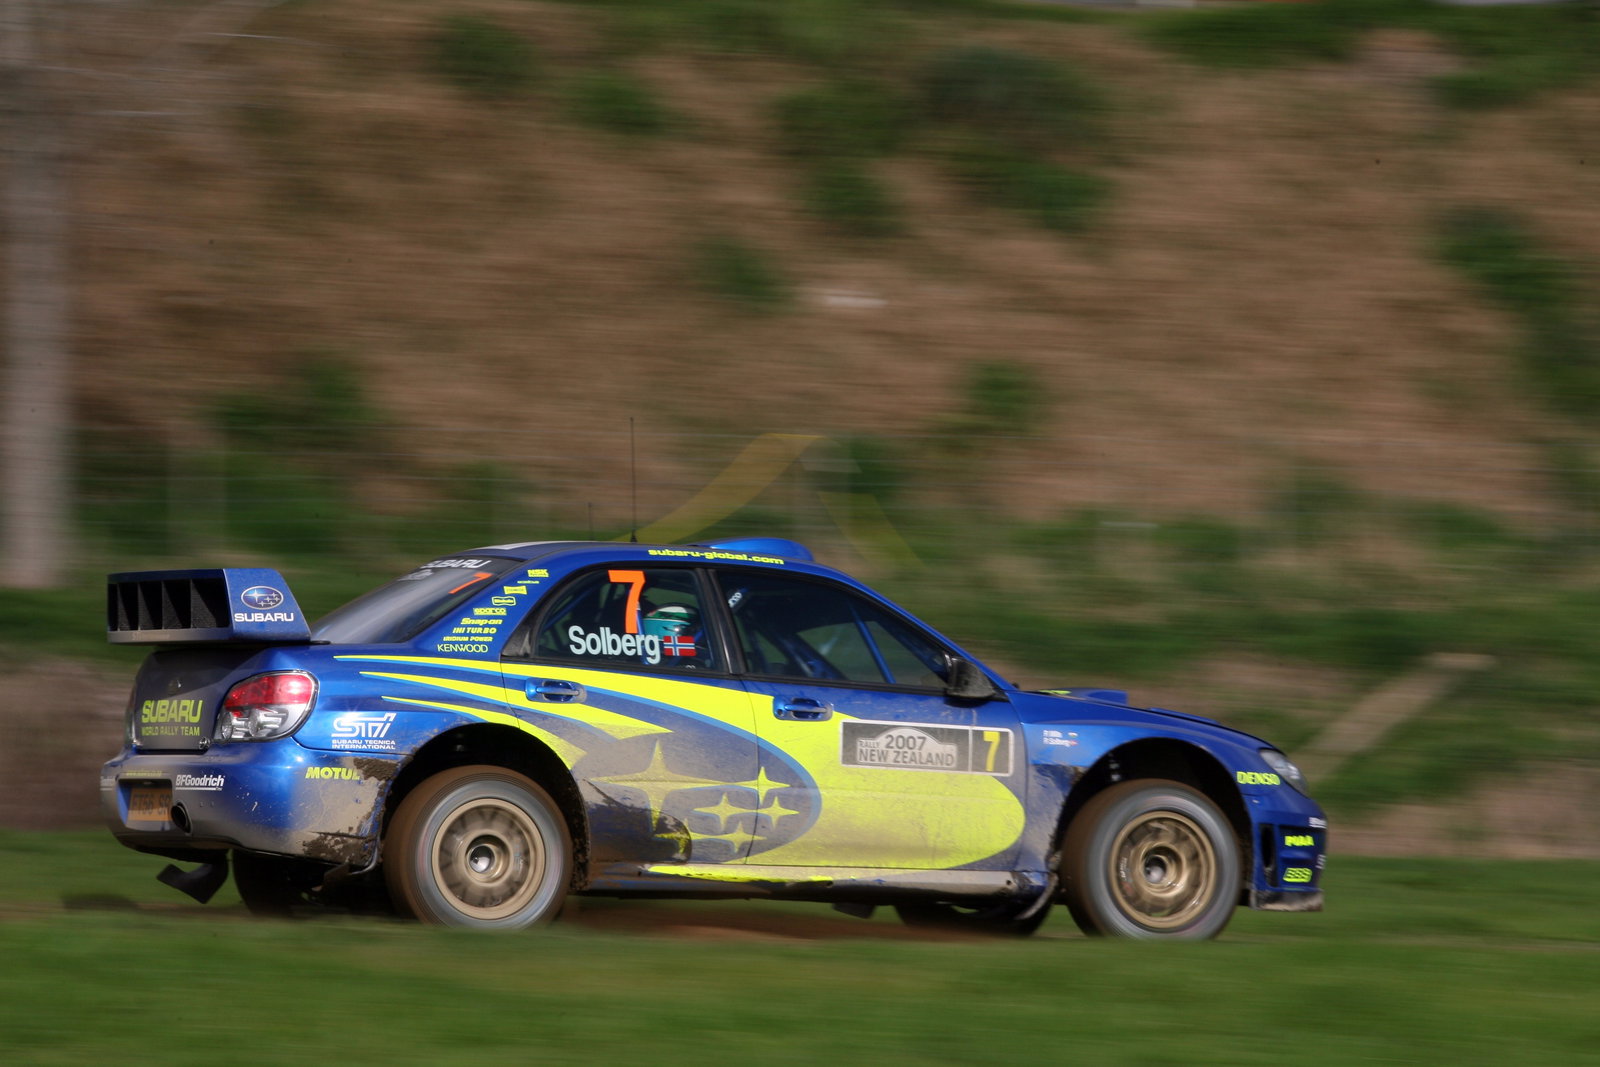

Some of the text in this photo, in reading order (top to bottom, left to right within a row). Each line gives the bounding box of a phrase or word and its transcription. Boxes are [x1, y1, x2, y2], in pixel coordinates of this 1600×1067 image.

[647, 548, 785, 565] subaru-global.com
[608, 569, 646, 634] 7
[234, 612, 295, 622] SUBARU
[460, 617, 503, 626] Snap-on
[437, 644, 489, 653] KENWOOD
[567, 625, 662, 665] Solberg
[141, 700, 203, 723] SUBARU
[141, 726, 200, 736] WORLD RALLY TEAM
[859, 740, 880, 749] RALLY
[885, 734, 927, 751] 2007
[858, 749, 955, 766] NEW ZEALAND
[983, 731, 1000, 772] 7
[175, 774, 225, 787] BFGoodrich
[305, 766, 361, 780] MOTUL
[1236, 771, 1281, 786] DENSO
